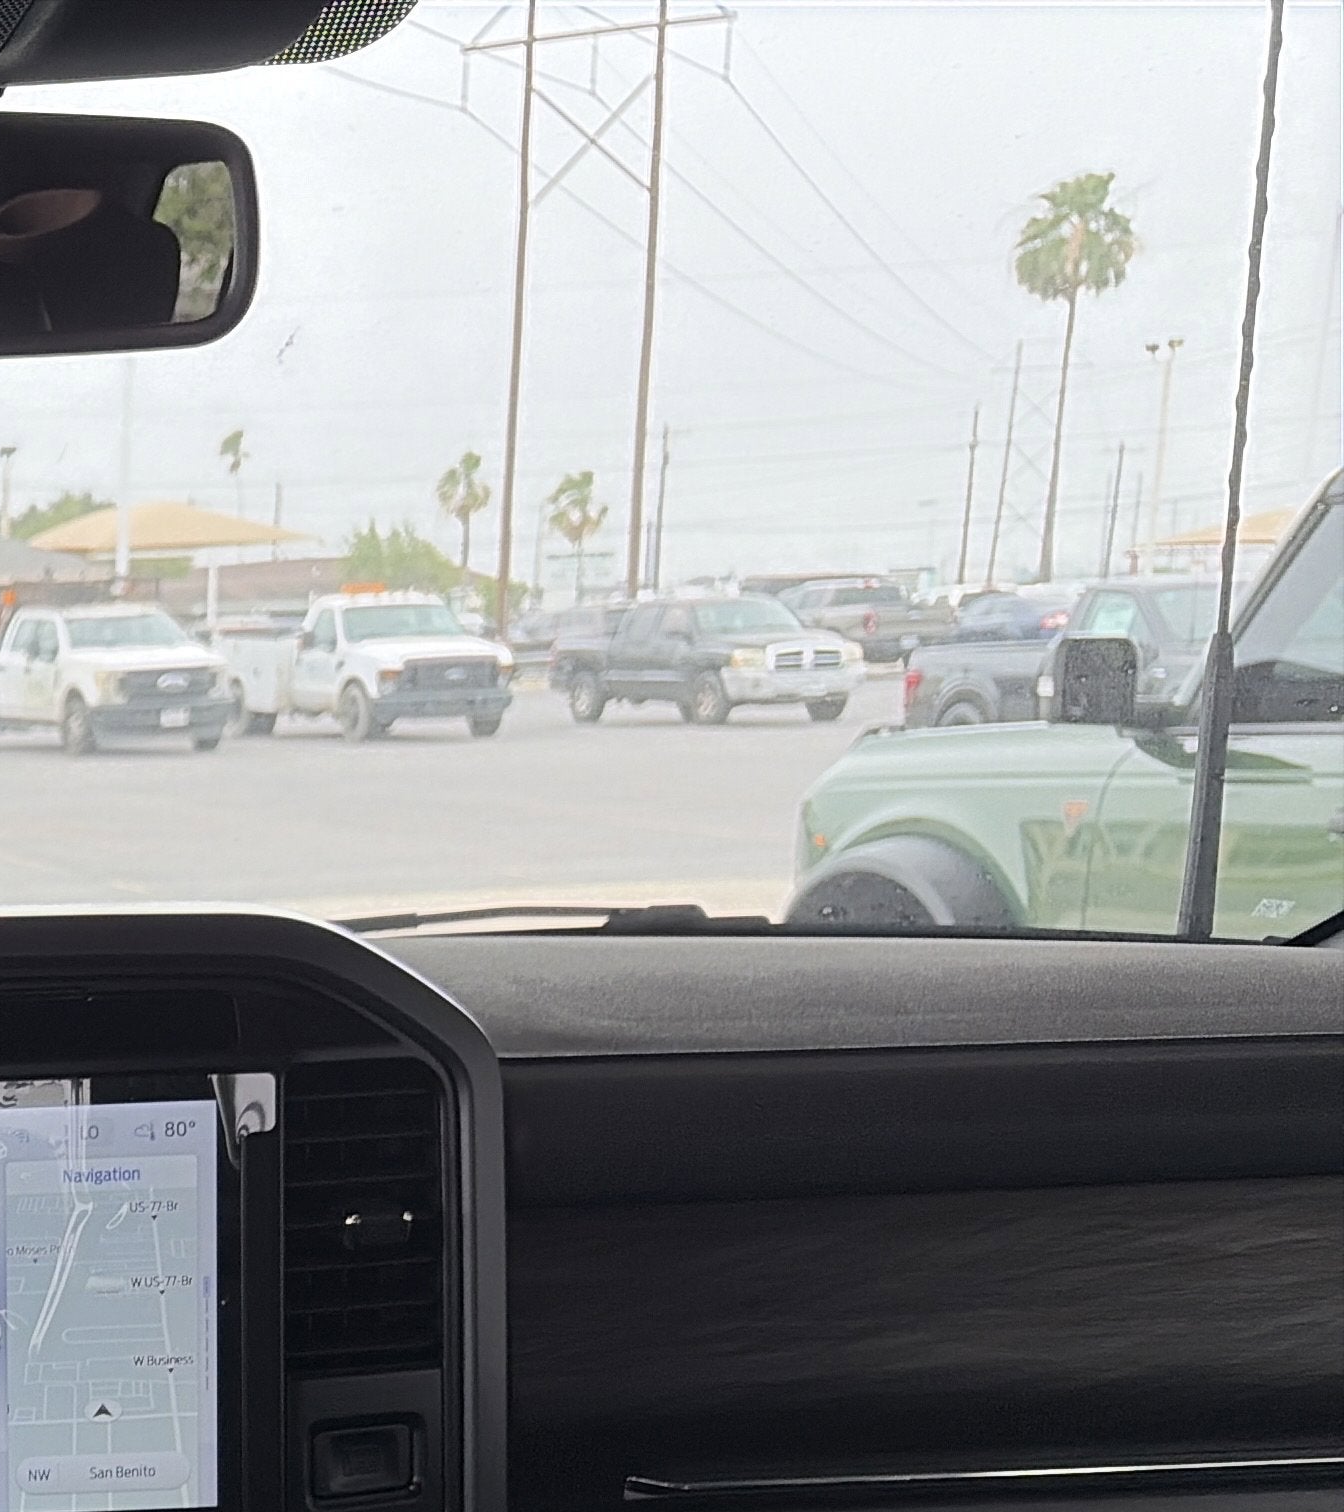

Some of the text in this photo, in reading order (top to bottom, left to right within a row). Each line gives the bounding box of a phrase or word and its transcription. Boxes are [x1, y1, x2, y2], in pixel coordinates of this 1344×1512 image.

[164, 1120, 196, 1137] 80°
[63, 1167, 141, 1185] Navigation
[131, 1277, 142, 1288] W
[133, 1354, 194, 1367] W Business
[28, 1469, 51, 1482] NW
[90, 1465, 156, 1480] San Benito
